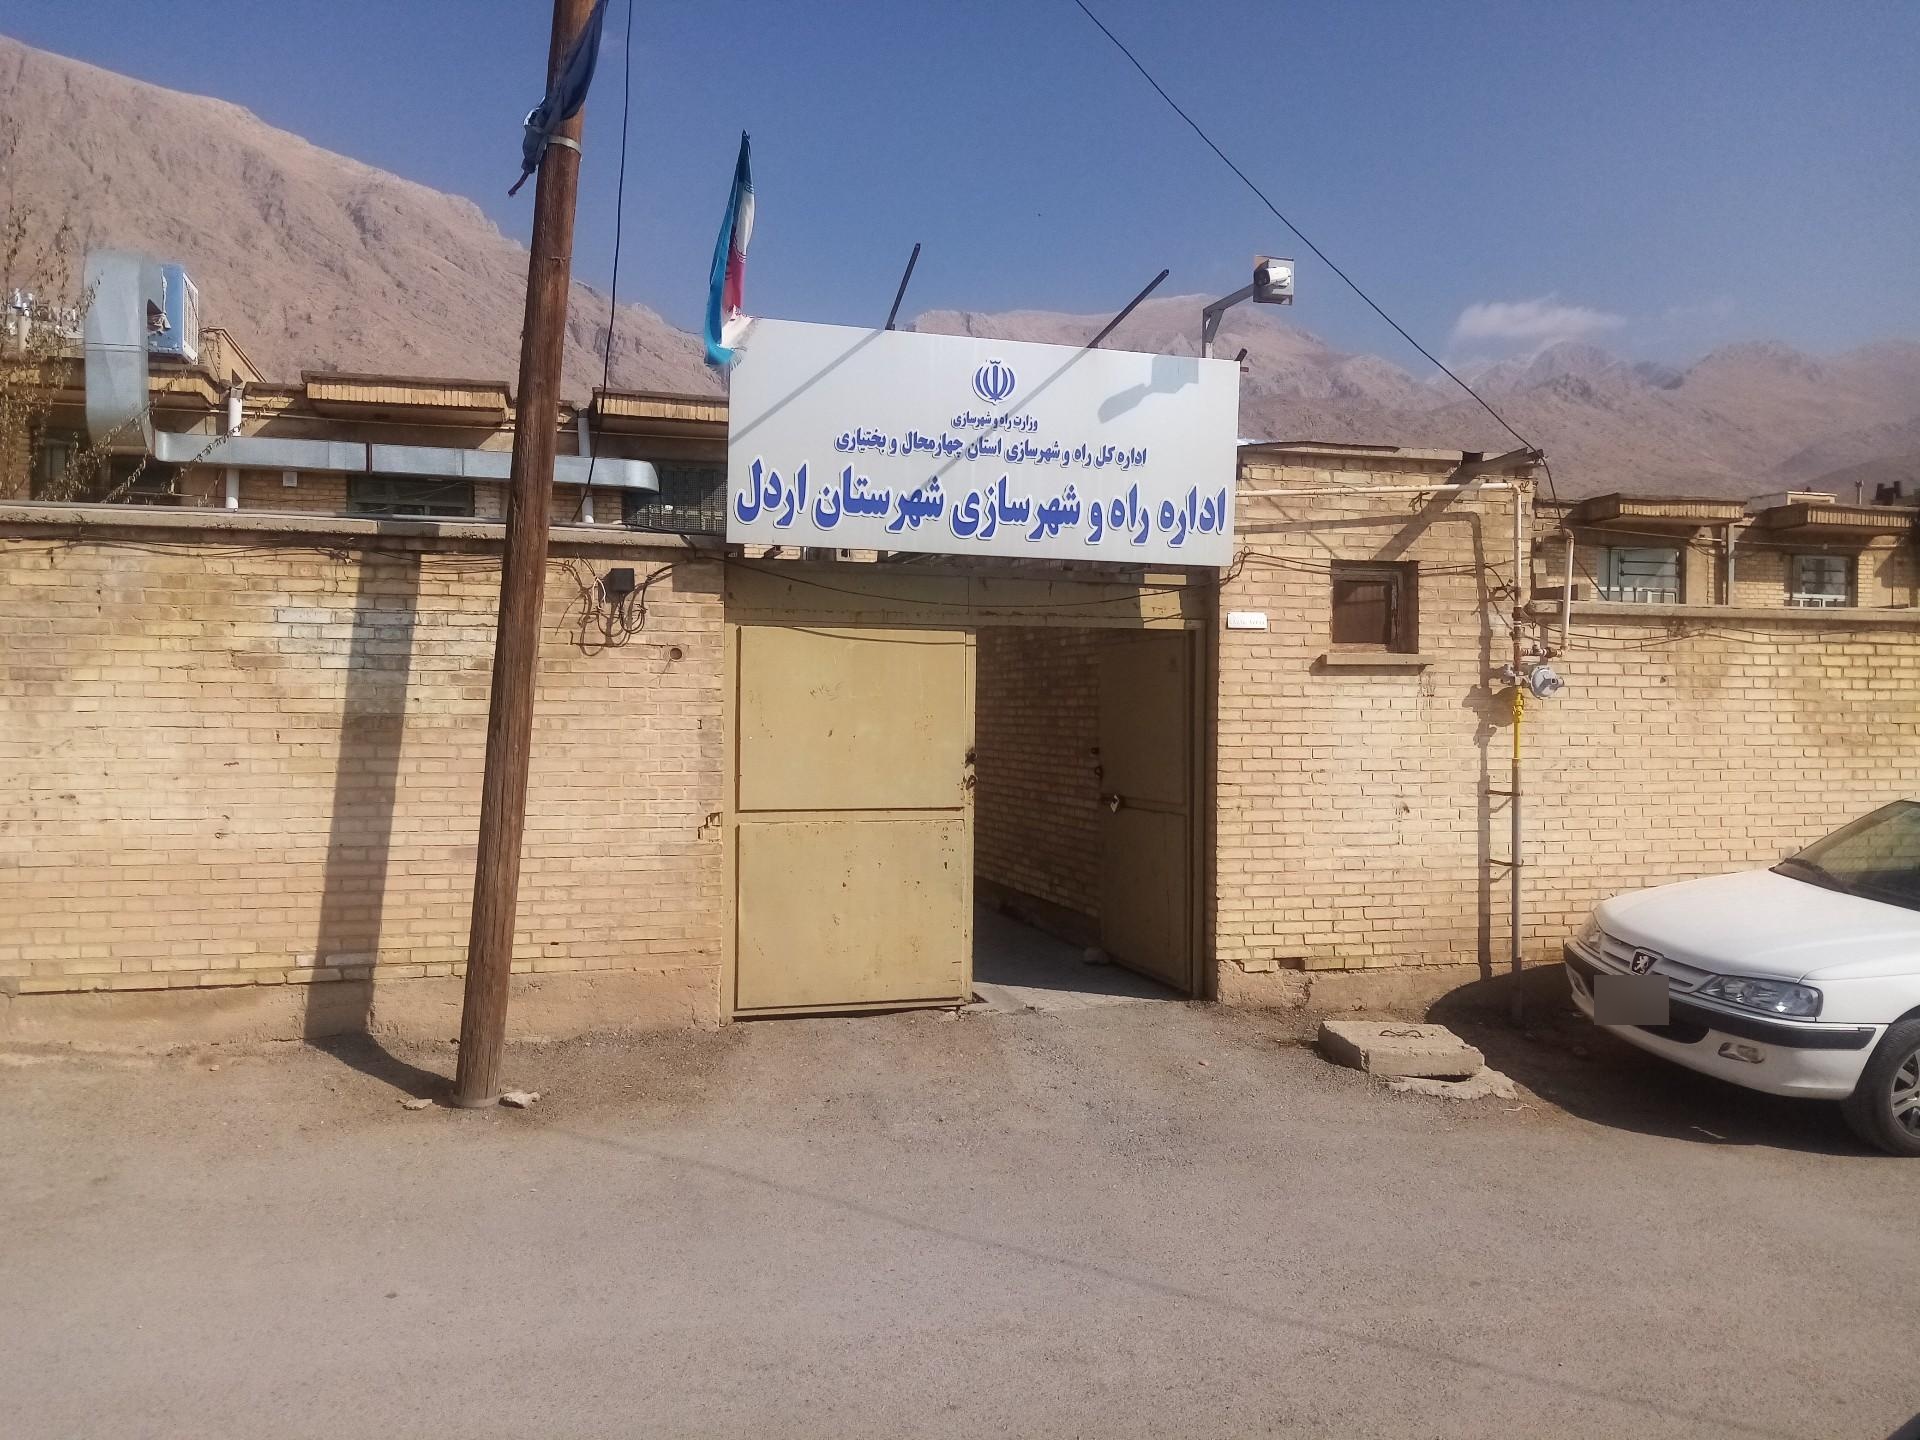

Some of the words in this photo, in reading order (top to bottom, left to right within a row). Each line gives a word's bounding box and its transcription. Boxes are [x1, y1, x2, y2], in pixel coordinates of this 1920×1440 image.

[951, 410, 992, 429] شهرسازی
[992, 416, 999, 428] و
[998, 413, 1012, 428] راه
[1014, 416, 1039, 431] وزارت
[835, 427, 887, 454] بختیاری
[889, 438, 898, 454] و
[966, 436, 1002, 461] استان
[1005, 439, 1060, 463] شهرسازی
[1062, 450, 1070, 466] و
[1072, 443, 1092, 466] راه
[1093, 446, 1116, 468] کل
[1117, 446, 1147, 468] اداره
[735, 458, 807, 529] اردل
[815, 464, 944, 533] شهرستان
[1087, 500, 1104, 545] و
[1110, 484, 1151, 545] راه
[1159, 485, 1226, 545] اداره
